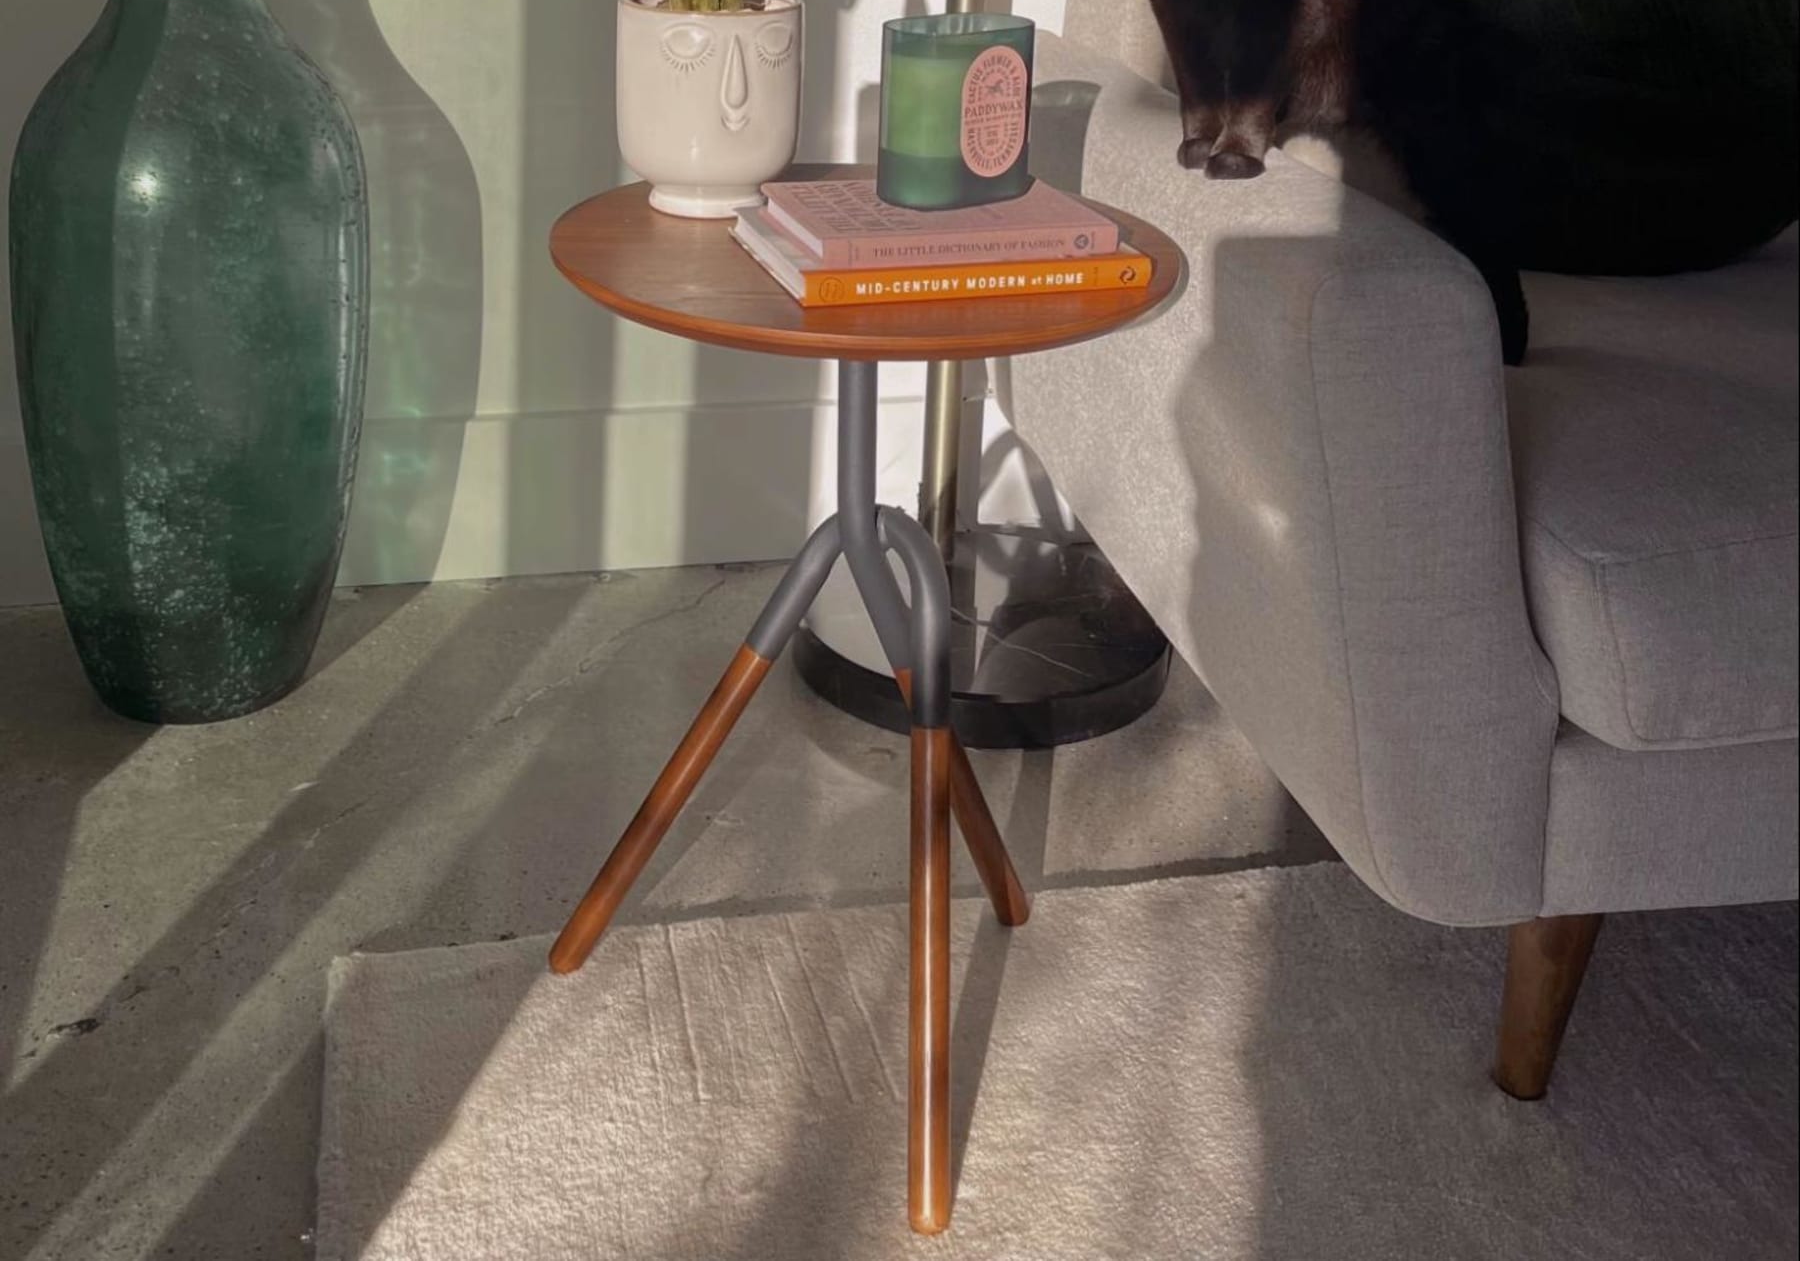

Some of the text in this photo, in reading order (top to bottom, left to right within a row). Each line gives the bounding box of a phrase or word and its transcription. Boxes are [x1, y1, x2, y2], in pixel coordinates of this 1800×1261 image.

[965, 100, 1023, 118] PADDYWAX
[873, 247, 895, 258] THE
[899, 244, 935, 256] LITTLE
[938, 241, 1001, 255] DICTIONARY
[1004, 241, 1017, 250] OF
[1020, 239, 1064, 250] FASHION
[856, 278, 960, 295] MID-CENTURY
[966, 275, 1026, 289] MODERN
[1031, 276, 1043, 285] at
[1046, 272, 1085, 285] HOME
